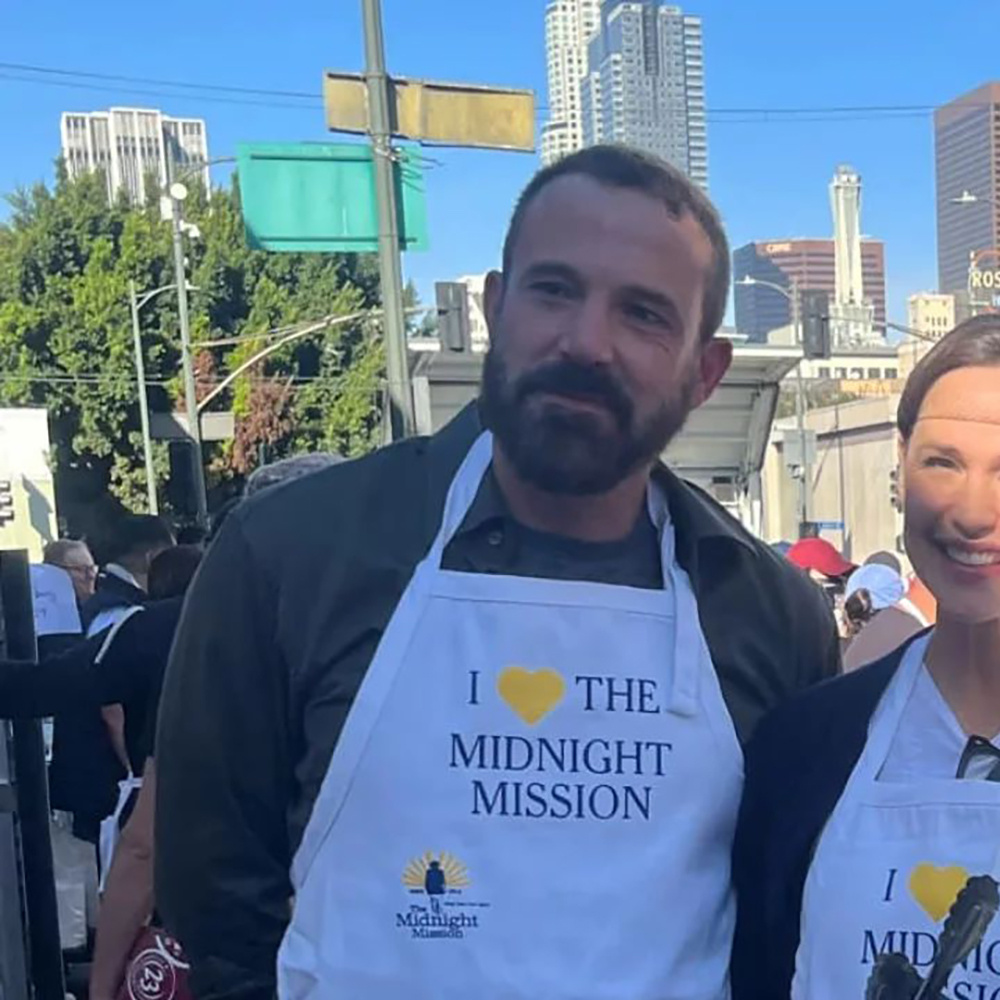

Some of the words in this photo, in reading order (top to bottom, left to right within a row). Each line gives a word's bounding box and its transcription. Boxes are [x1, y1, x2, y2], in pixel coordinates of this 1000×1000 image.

[469, 671, 480, 704] I
[576, 675, 660, 713] THE
[449, 732, 673, 776] MIDNIGHT
[470, 780, 652, 820] MISSION
[884, 869, 897, 901] I
[395, 912, 479, 930] Midnight
